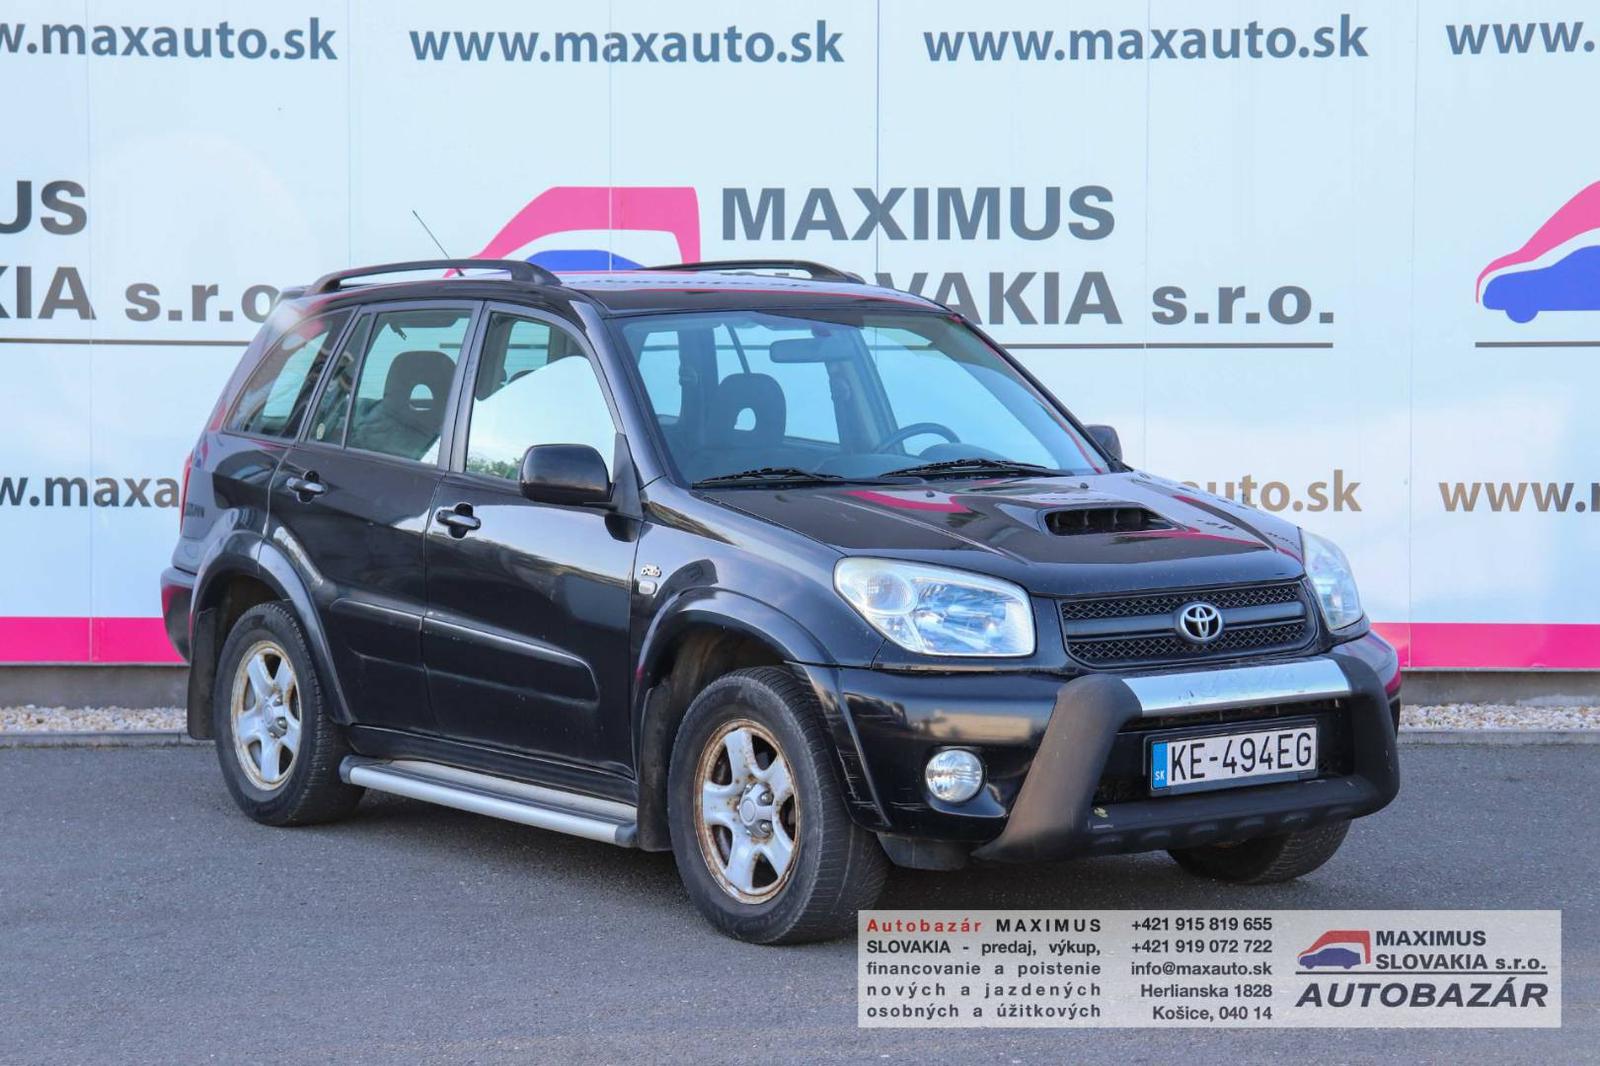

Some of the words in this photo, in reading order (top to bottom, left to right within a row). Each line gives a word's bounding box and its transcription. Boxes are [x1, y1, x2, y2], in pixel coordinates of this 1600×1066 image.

[409, 19, 845, 64] www.maxauto.sk
[923, 13, 1369, 62] www.maxauto.sk
[1445, 21, 1595, 56] www.
[722, 185, 1115, 241] MAXIMUS
[0, 265, 97, 321] IA
[1151, 285, 1334, 326] s.r.o.
[1154, 769, 1166, 781] SK
[1170, 732, 1312, 782] KE-494EG
